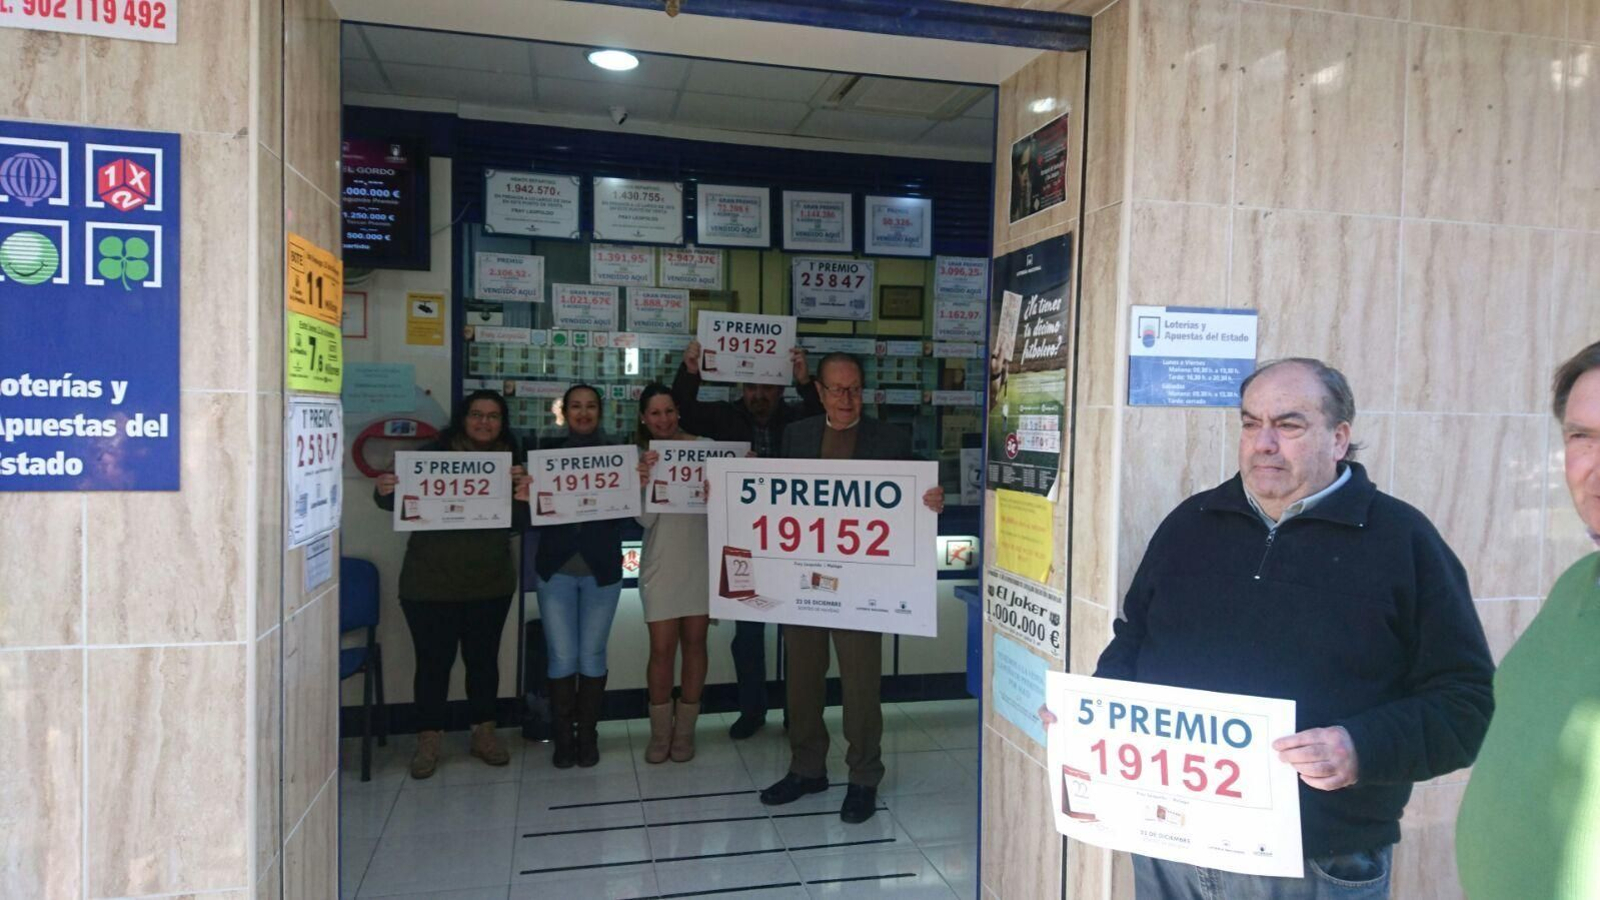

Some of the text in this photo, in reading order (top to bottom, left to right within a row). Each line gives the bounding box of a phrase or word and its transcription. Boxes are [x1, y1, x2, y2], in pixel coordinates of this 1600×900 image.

[23, 0, 66, 18] 902
[77, 0, 116, 24] 119
[124, 1, 166, 29] 492
[356, 167, 395, 175] GORDO
[105, 163, 146, 208] 1 X 2
[343, 187, 390, 197] .000.000
[347, 232, 383, 240] 500.000
[819, 262, 858, 273] PREMIO
[801, 272, 865, 288] 25847
[307, 271, 323, 309] 11
[1038, 298, 1061, 314] tienes
[727, 321, 782, 335] PREMIO
[1033, 317, 1061, 337] décimo
[1165, 320, 1206, 332] Loterías y
[717, 336, 776, 354] 19152
[1164, 332, 1249, 342] Apuestas del Estado
[0, 373, 128, 405] oterías y
[0, 413, 168, 442] puestas del
[0, 451, 83, 475] stado
[430, 461, 495, 474] PREMIO
[561, 454, 623, 471] PREMIO
[553, 472, 620, 491] 19152
[669, 466, 702, 482] 191
[420, 479, 490, 496] 19152
[771, 478, 902, 509] PREMIO
[752, 515, 891, 557] 19152
[733, 559, 750, 576] 22
[996, 585, 1008, 600] El
[1007, 591, 1047, 616] Joker
[987, 599, 1045, 641] 1.000.000
[1050, 630, 1060, 649] €
[1109, 701, 1252, 749] PREMIO
[1090, 738, 1243, 799] 19152
